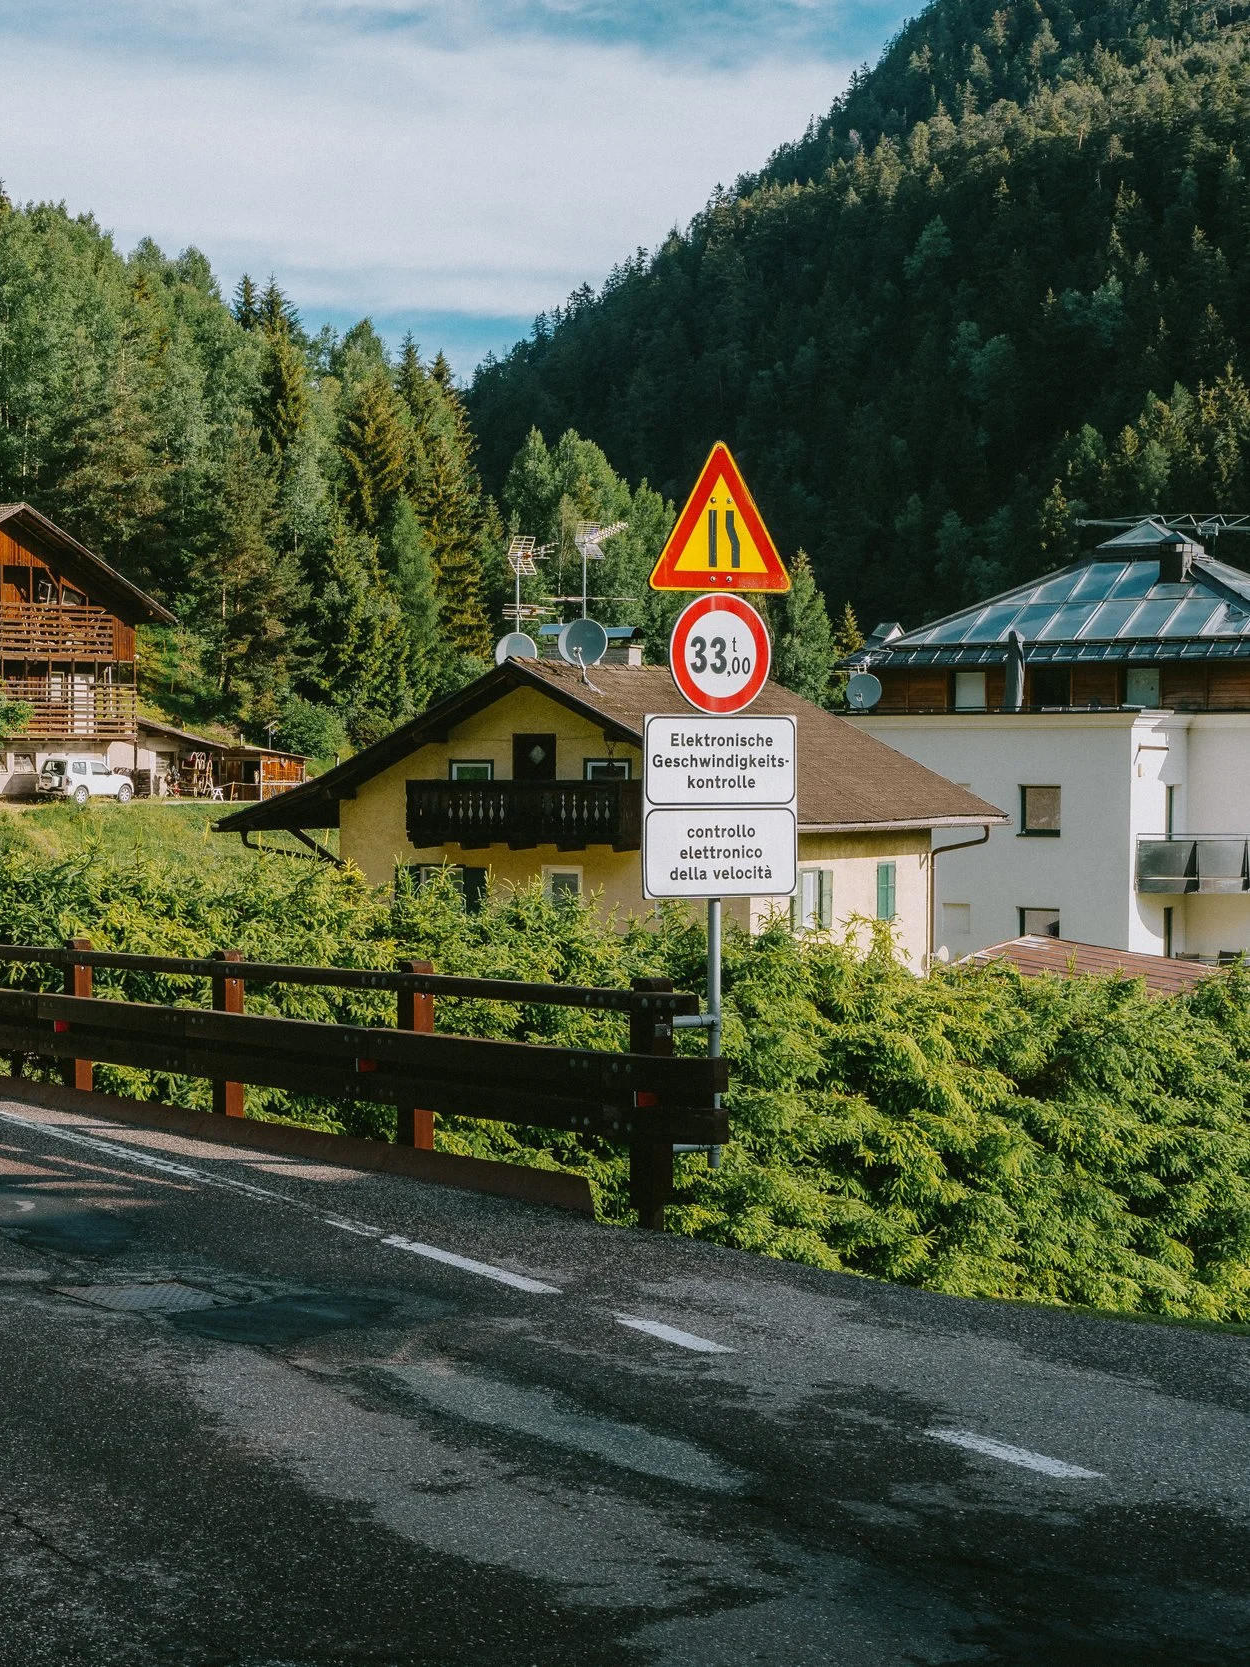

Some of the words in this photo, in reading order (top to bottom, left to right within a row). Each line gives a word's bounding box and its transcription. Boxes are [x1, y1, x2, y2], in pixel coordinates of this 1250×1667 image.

[732, 637, 737, 652] t
[670, 733, 773, 746] Elektronische
[652, 754, 790, 770] Geschwindigkeits-
[687, 775, 756, 788] kontrolle
[687, 824, 756, 838] controllo
[680, 845, 763, 859] elettronico
[670, 867, 707, 880] della
[713, 865, 772, 879] velocità
